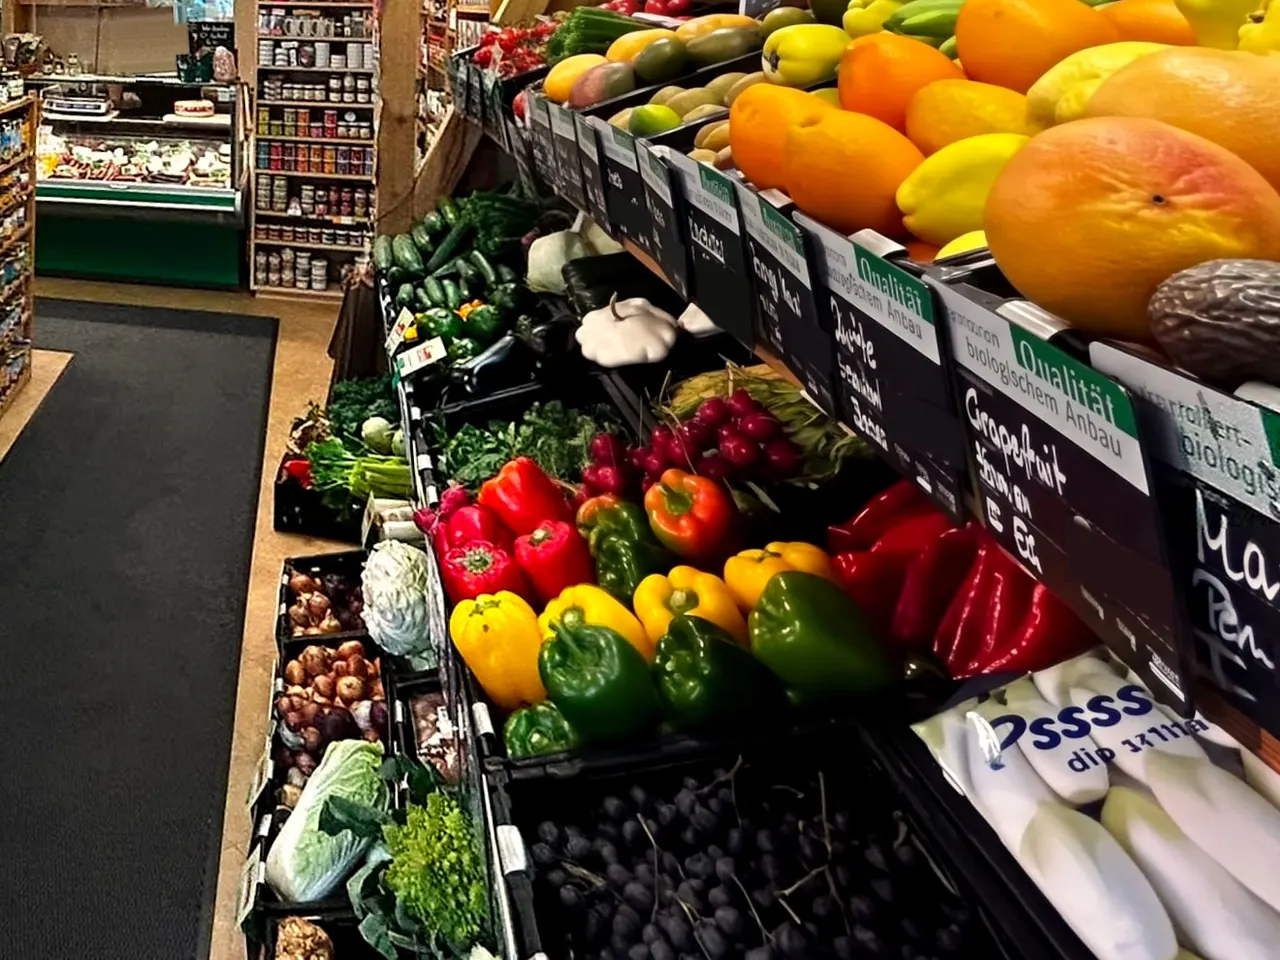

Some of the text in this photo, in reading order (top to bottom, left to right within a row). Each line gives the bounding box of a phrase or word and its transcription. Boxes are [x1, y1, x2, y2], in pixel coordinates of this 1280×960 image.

[860, 257, 923, 318] Qualität
[966, 336, 1122, 458] biologischem Anbau
[1019, 340, 1116, 426] Qualität
[966, 388, 1067, 496] Grapefruit
[1067, 746, 1116, 773] dip
